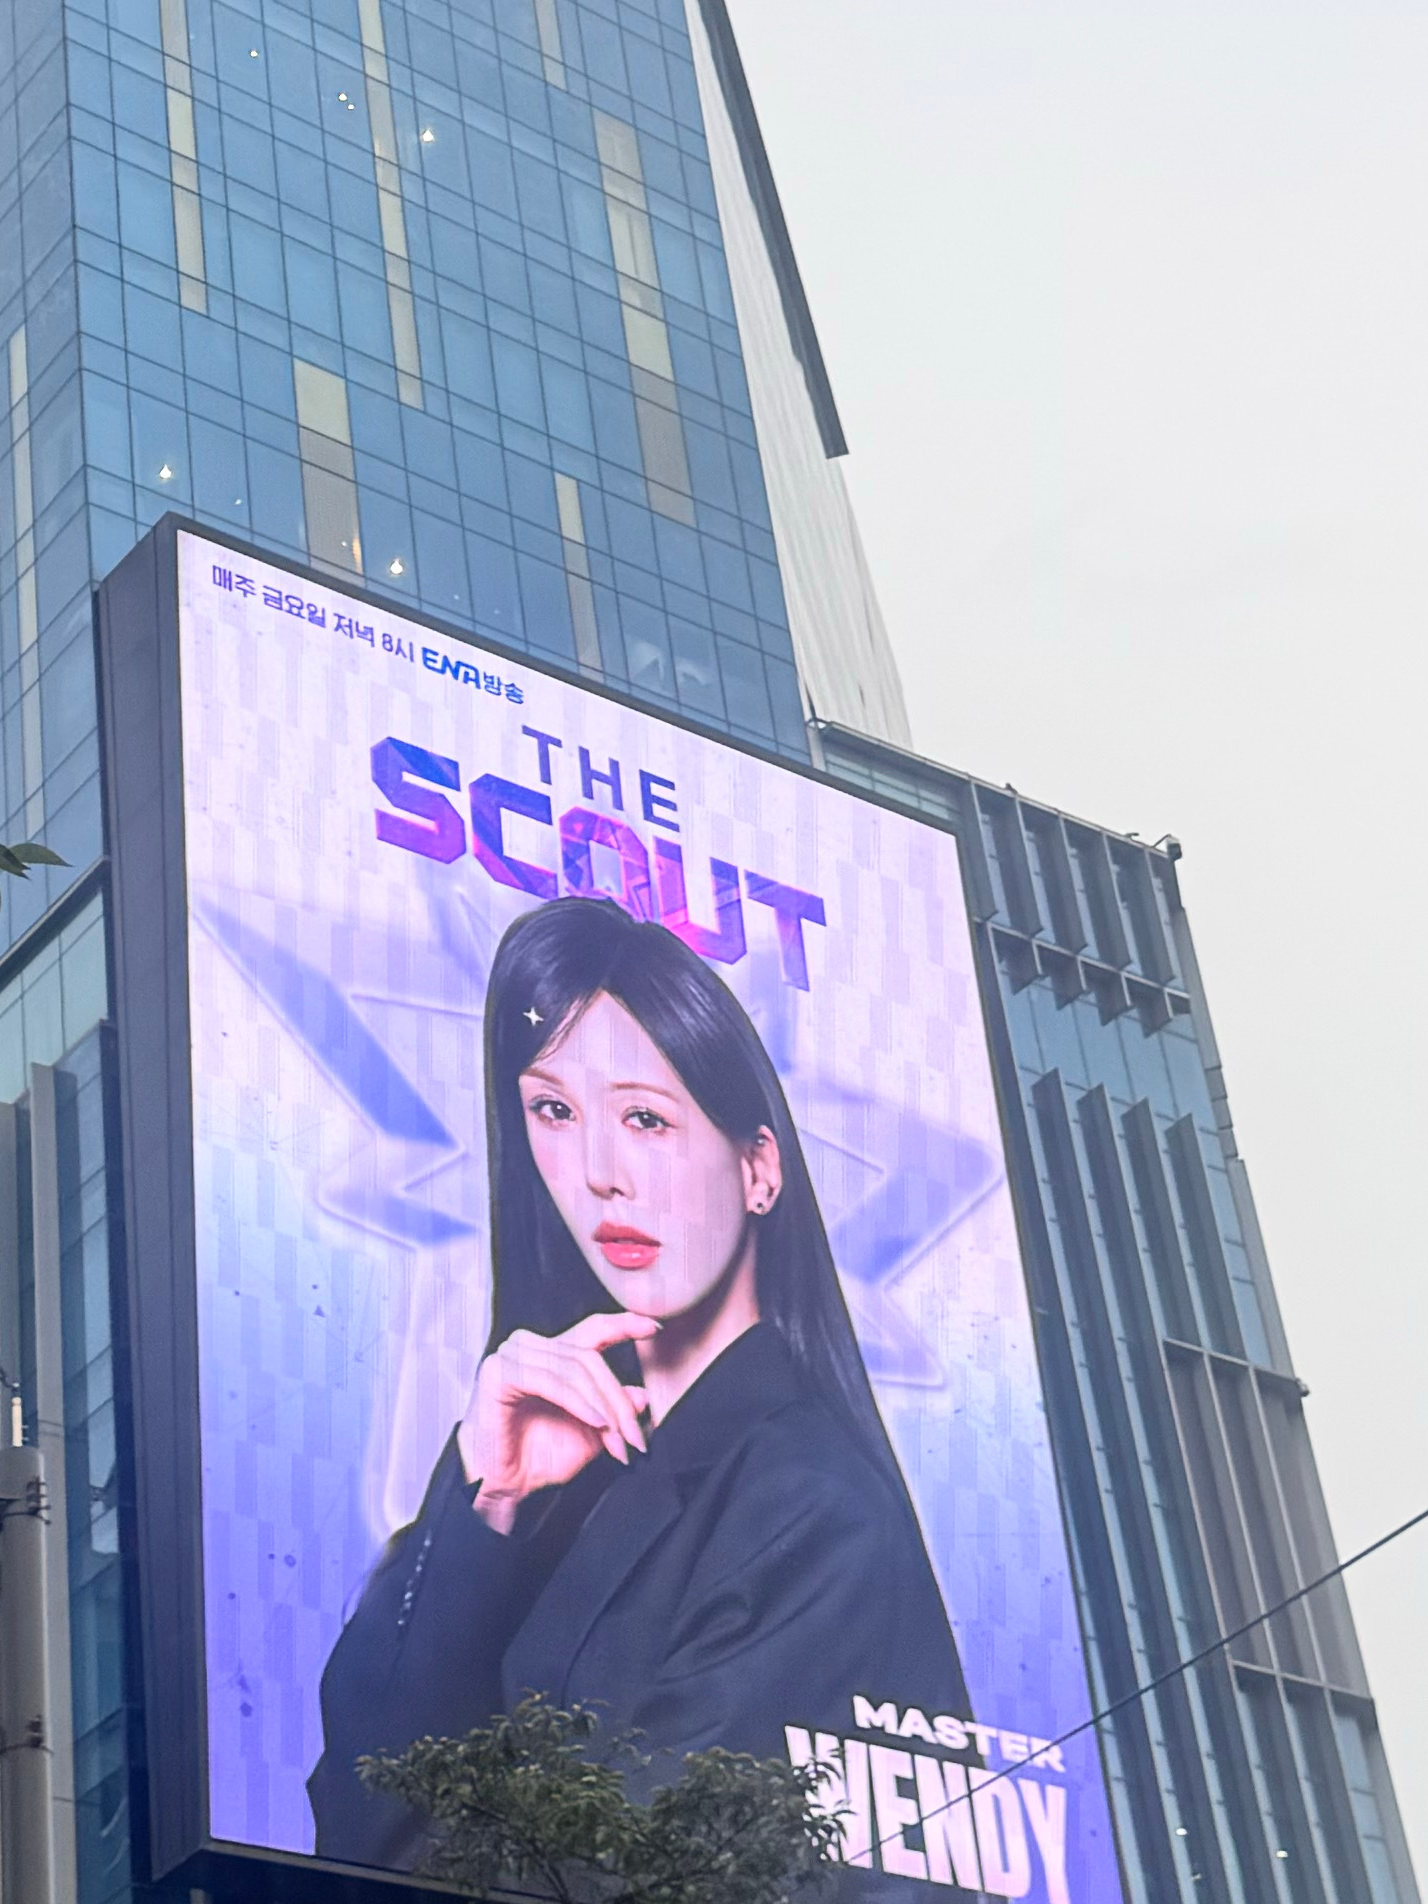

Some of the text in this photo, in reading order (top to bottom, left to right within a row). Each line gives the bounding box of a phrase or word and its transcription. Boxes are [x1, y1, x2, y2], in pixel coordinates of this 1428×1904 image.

[212, 564, 257, 598] 매주
[262, 584, 327, 629] 금요일
[333, 611, 375, 648] 저녁
[381, 632, 415, 663] 8시
[521, 724, 681, 833] THE
[371, 735, 828, 993] SCOUT
[852, 1694, 1066, 1773] MASTER
